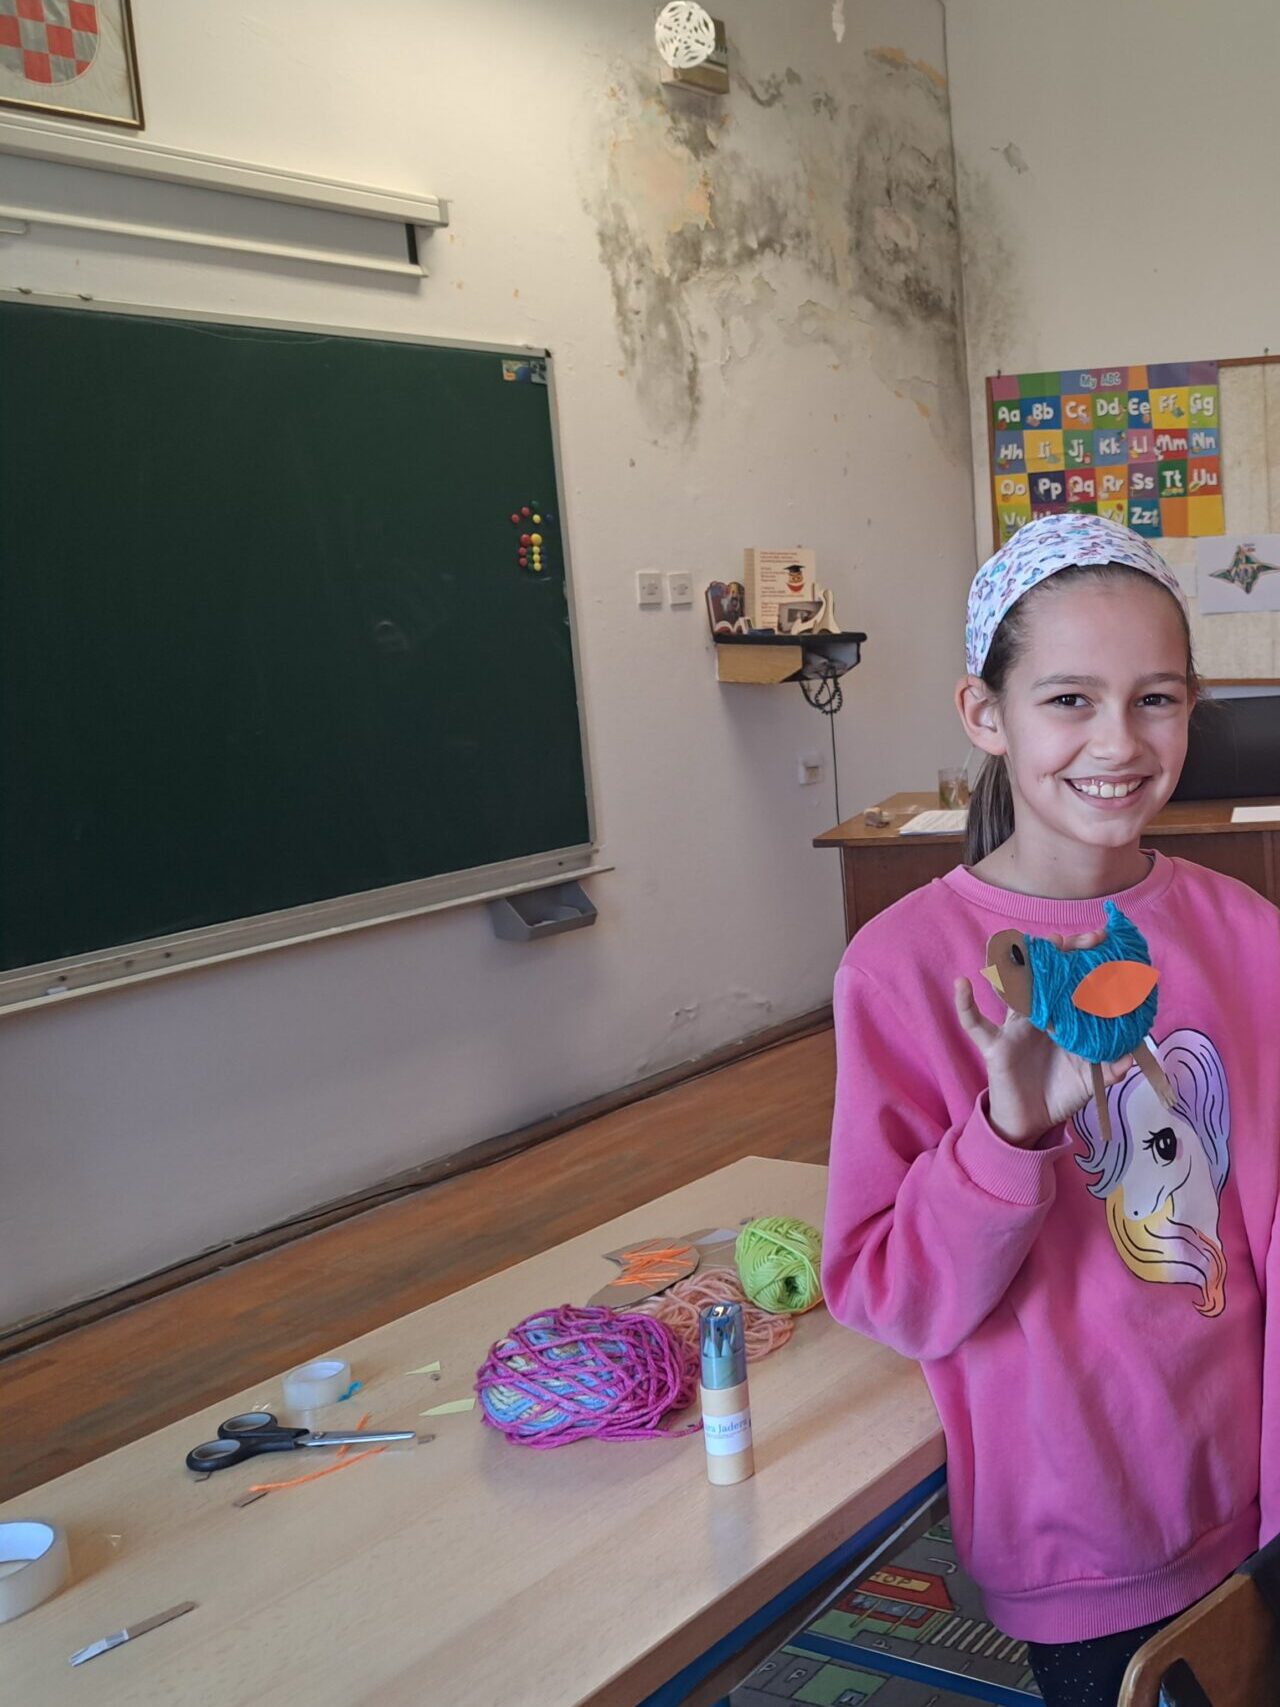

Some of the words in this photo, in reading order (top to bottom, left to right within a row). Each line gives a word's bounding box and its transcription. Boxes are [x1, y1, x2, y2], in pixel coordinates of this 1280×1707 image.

[1079, 373, 1097, 389] My
[1100, 371, 1121, 386] ABC
[998, 406, 1020, 423] Aa
[1031, 402, 1054, 420] Bb
[1066, 401, 1088, 418] Cc
[1096, 396, 1119, 416] Dd
[1128, 397, 1150, 415] Ee
[1159, 394, 1178, 413] Ff
[1190, 393, 1214, 416] Gg
[1000, 442, 1023, 460] Hh
[1038, 441, 1051, 459] Ii
[1068, 439, 1084, 463] Jj
[1099, 436, 1121, 455] Kk
[1132, 435, 1147, 453] Ll
[1156, 434, 1188, 452] Mm
[1191, 431, 1216, 449] Nn
[1000, 479, 1026, 496] Oo
[1038, 478, 1062, 500] Pp
[1069, 475, 1095, 498] Qq
[1103, 475, 1124, 492] Rr
[1131, 472, 1154, 490] Ss
[1162, 469, 1182, 488] Tt
[1192, 468, 1217, 486] Uu
[1003, 511, 1026, 526] Vv
[1131, 506, 1152, 524] Zz
